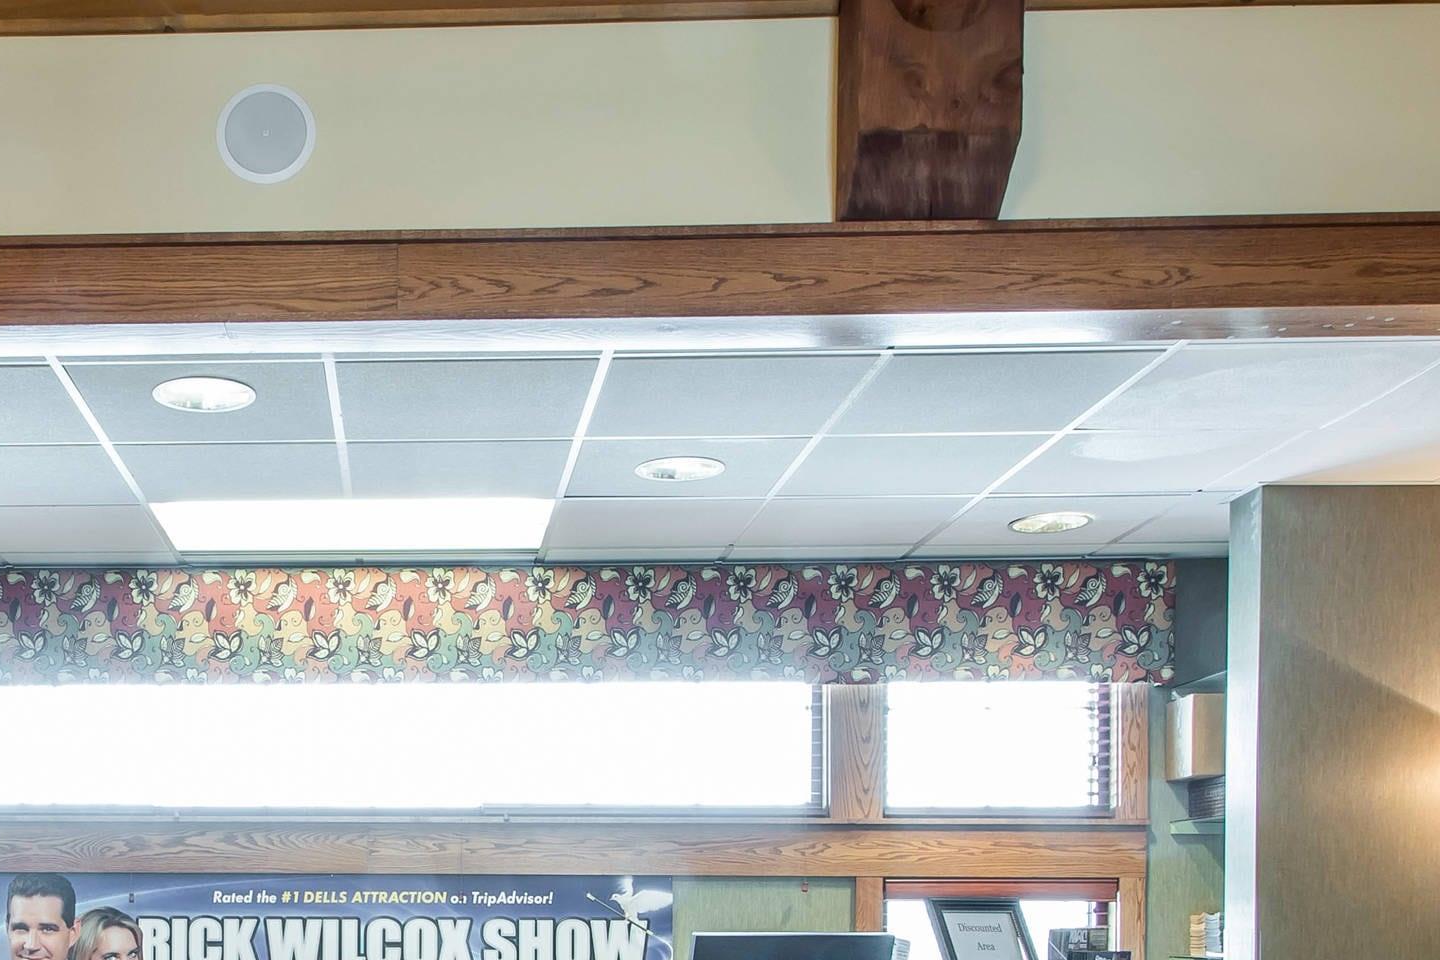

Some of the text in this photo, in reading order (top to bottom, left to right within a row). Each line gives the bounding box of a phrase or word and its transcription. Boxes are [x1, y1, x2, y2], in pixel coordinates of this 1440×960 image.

[213, 890, 253, 904] Rated
[256, 890, 277, 904] the
[281, 891, 300, 904] #1
[303, 891, 348, 904] DELLS
[351, 891, 448, 904] ATTRACTION
[471, 890, 554, 907] TripAdvisor!
[957, 922, 1003, 933] Discounted
[977, 941, 996, 951] Area
